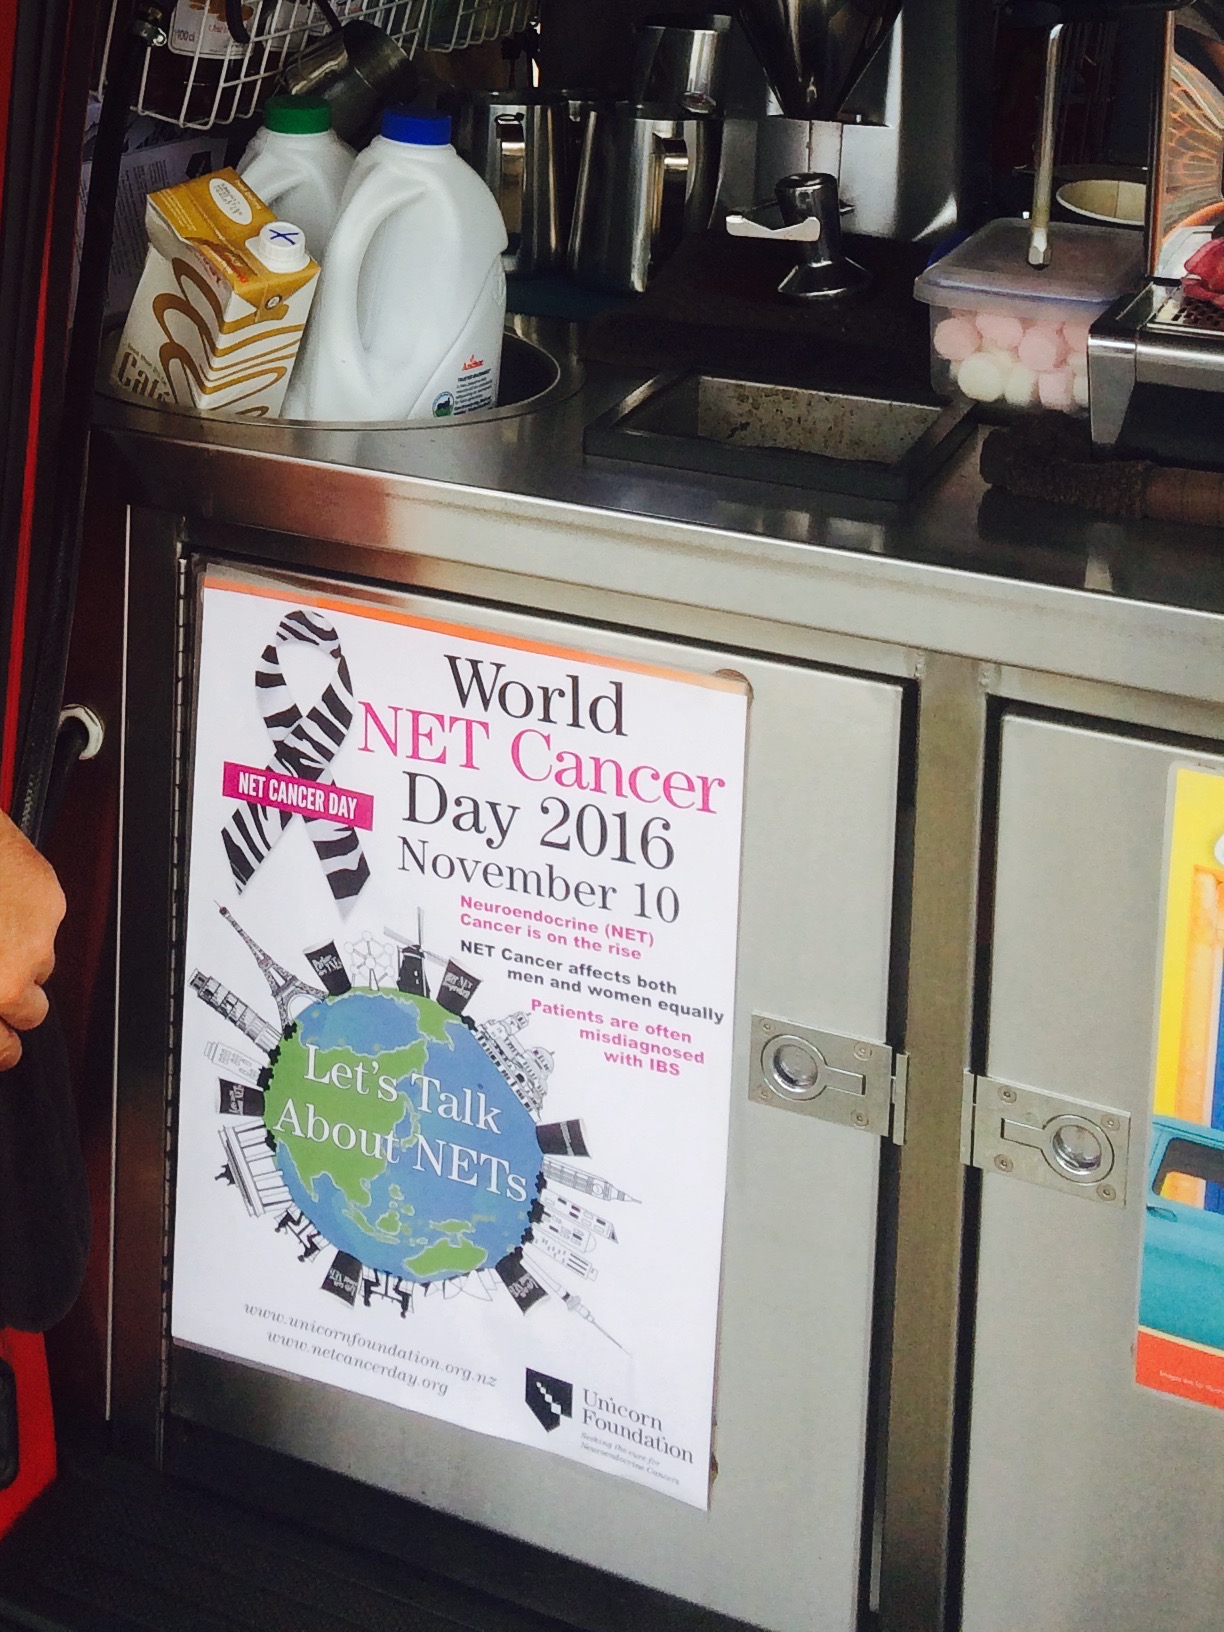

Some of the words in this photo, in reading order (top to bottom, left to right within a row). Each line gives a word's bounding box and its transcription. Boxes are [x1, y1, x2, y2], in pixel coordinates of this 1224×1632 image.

[444, 654, 628, 738] World
[358, 701, 490, 770] NET
[511, 729, 726, 814] Cancer
[238, 771, 267, 798] NET
[269, 777, 326, 812] CANCER
[329, 792, 357, 820] DAY
[402, 770, 520, 850] Day
[540, 796, 675, 870] 2016
[398, 836, 616, 911] November
[633, 883, 681, 924] 10
[460, 895, 599, 934] Neuroendocrine
[605, 923, 655, 948] (NET)
[460, 913, 522, 936] Cancer
[527, 925, 541, 940] is
[547, 932, 567, 946] on
[574, 936, 602, 952] the
[608, 943, 642, 960] rise
[460, 940, 495, 958] NET
[502, 948, 563, 971] Cancer
[569, 963, 631, 985] affects
[637, 975, 677, 995] both
[507, 969, 544, 986] men
[550, 977, 582, 993] and
[588, 985, 652, 1008] women
[658, 1000, 725, 1025] equally
[531, 998, 604, 1024] Patients
[610, 1017, 639, 1032] are
[646, 1024, 692, 1044] often
[579, 1027, 705, 1064] misdiagnosed
[604, 1050, 643, 1069] with
[650, 1060, 681, 1077] IBS
[304, 1044, 398, 1102] Let's
[410, 1074, 502, 1135] Talk
[273, 1098, 400, 1164] About
[413, 1134, 528, 1202] NETs
[244, 1302, 498, 1388] www.unicornfoundation.org.nz
[267, 1330, 449, 1397] www.netcancerday.org
[582, 1408, 694, 1464] Foundation
[583, 1388, 663, 1432] Unicorn
